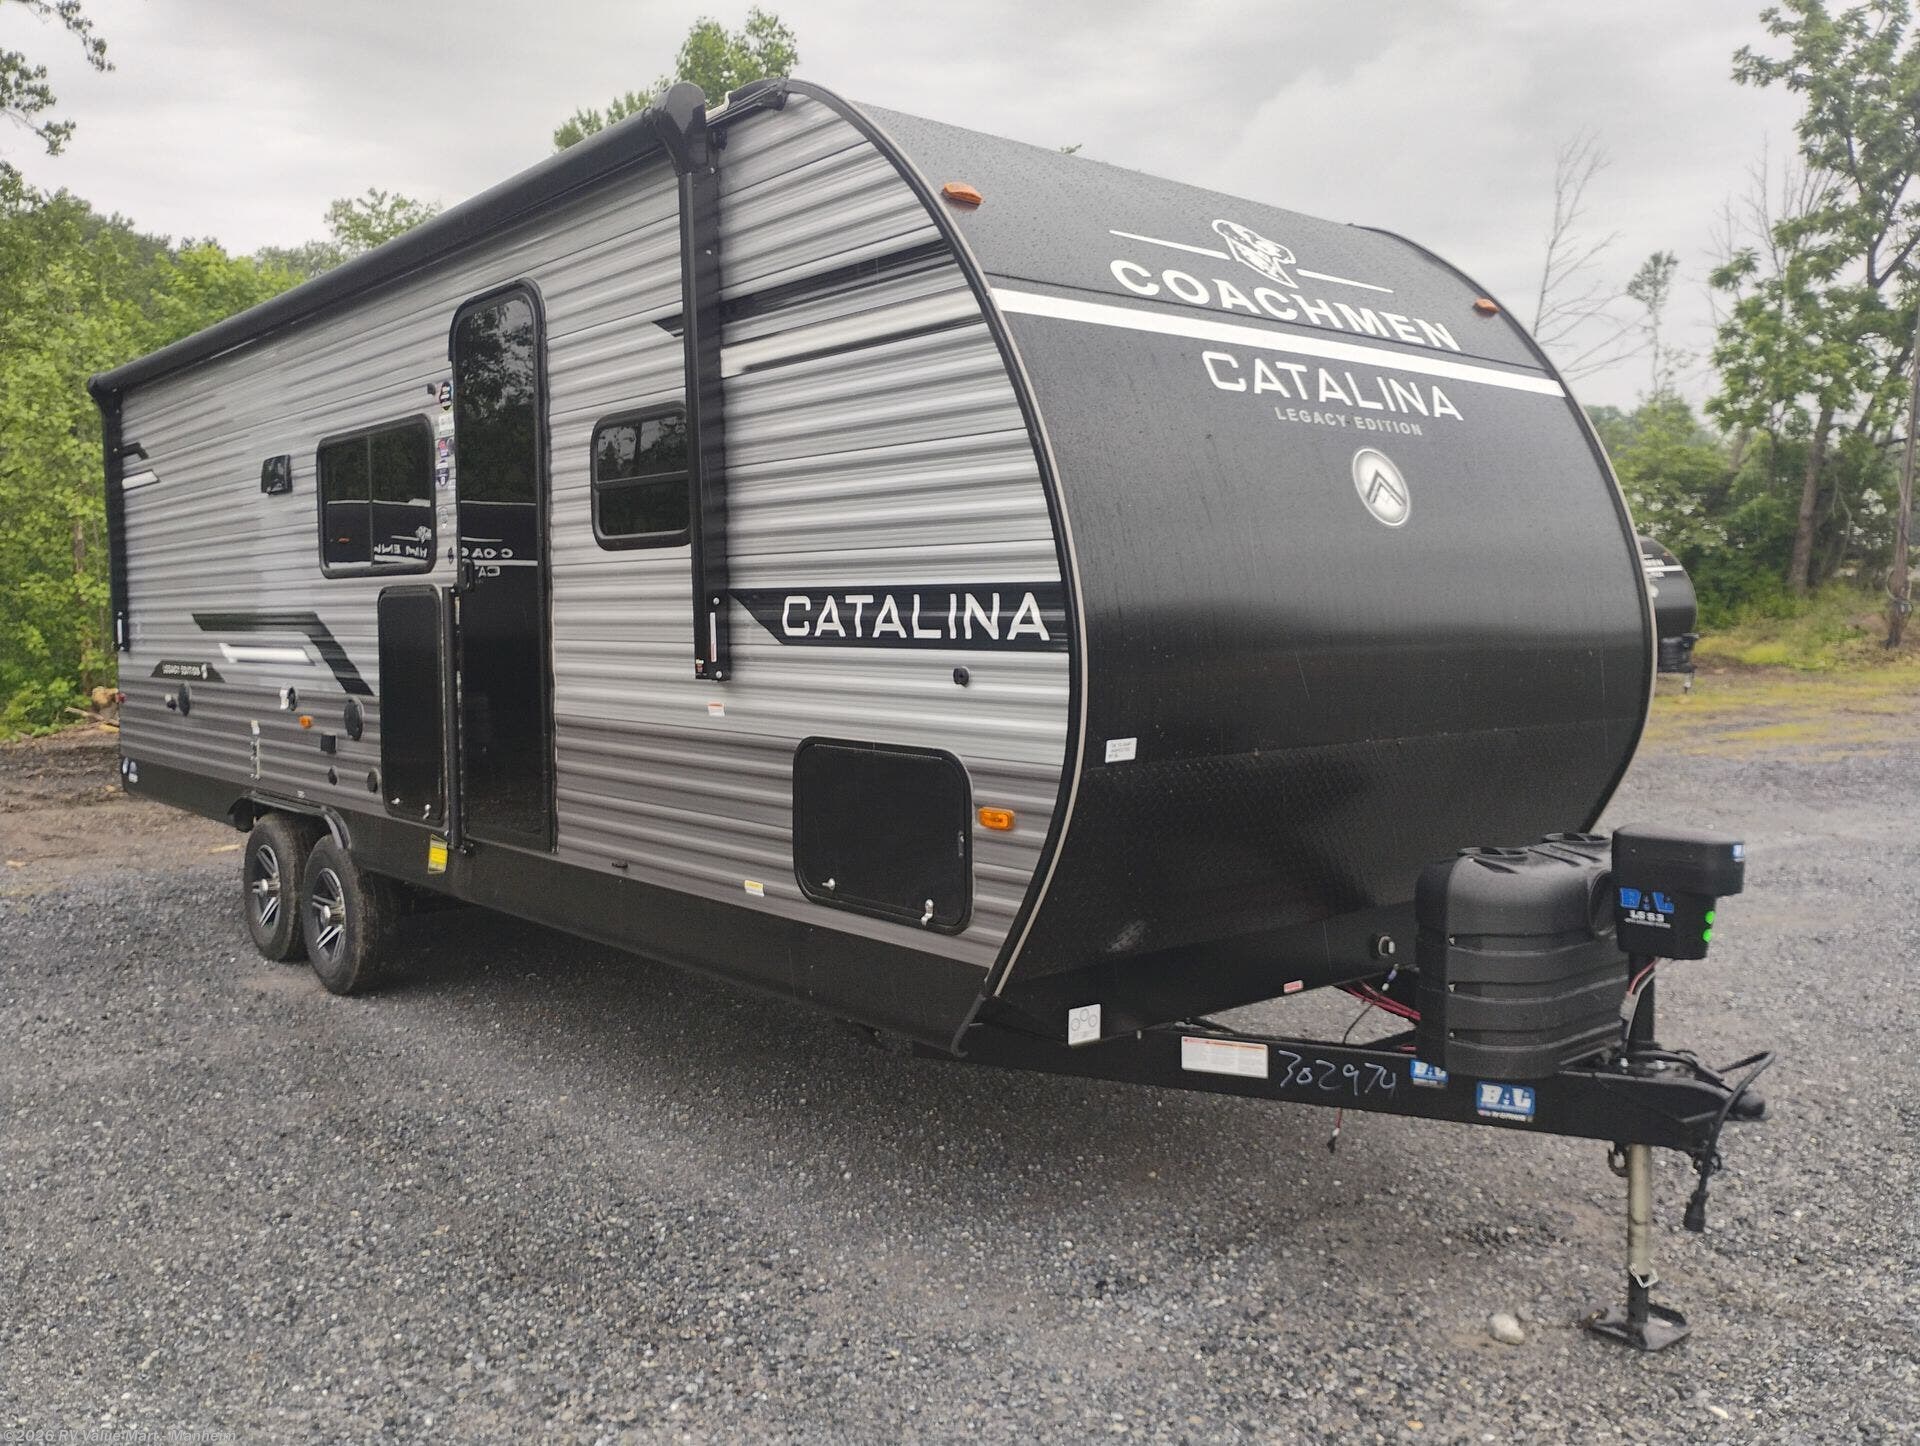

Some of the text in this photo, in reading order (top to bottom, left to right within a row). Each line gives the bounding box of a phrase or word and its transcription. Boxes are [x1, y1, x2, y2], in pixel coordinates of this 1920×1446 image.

[1110, 260, 1461, 351] COACHMEN
[1202, 351, 1464, 421] CATALINA
[1275, 407, 1422, 436] LEGACY EDITION
[781, 592, 1050, 641] CATALINA
